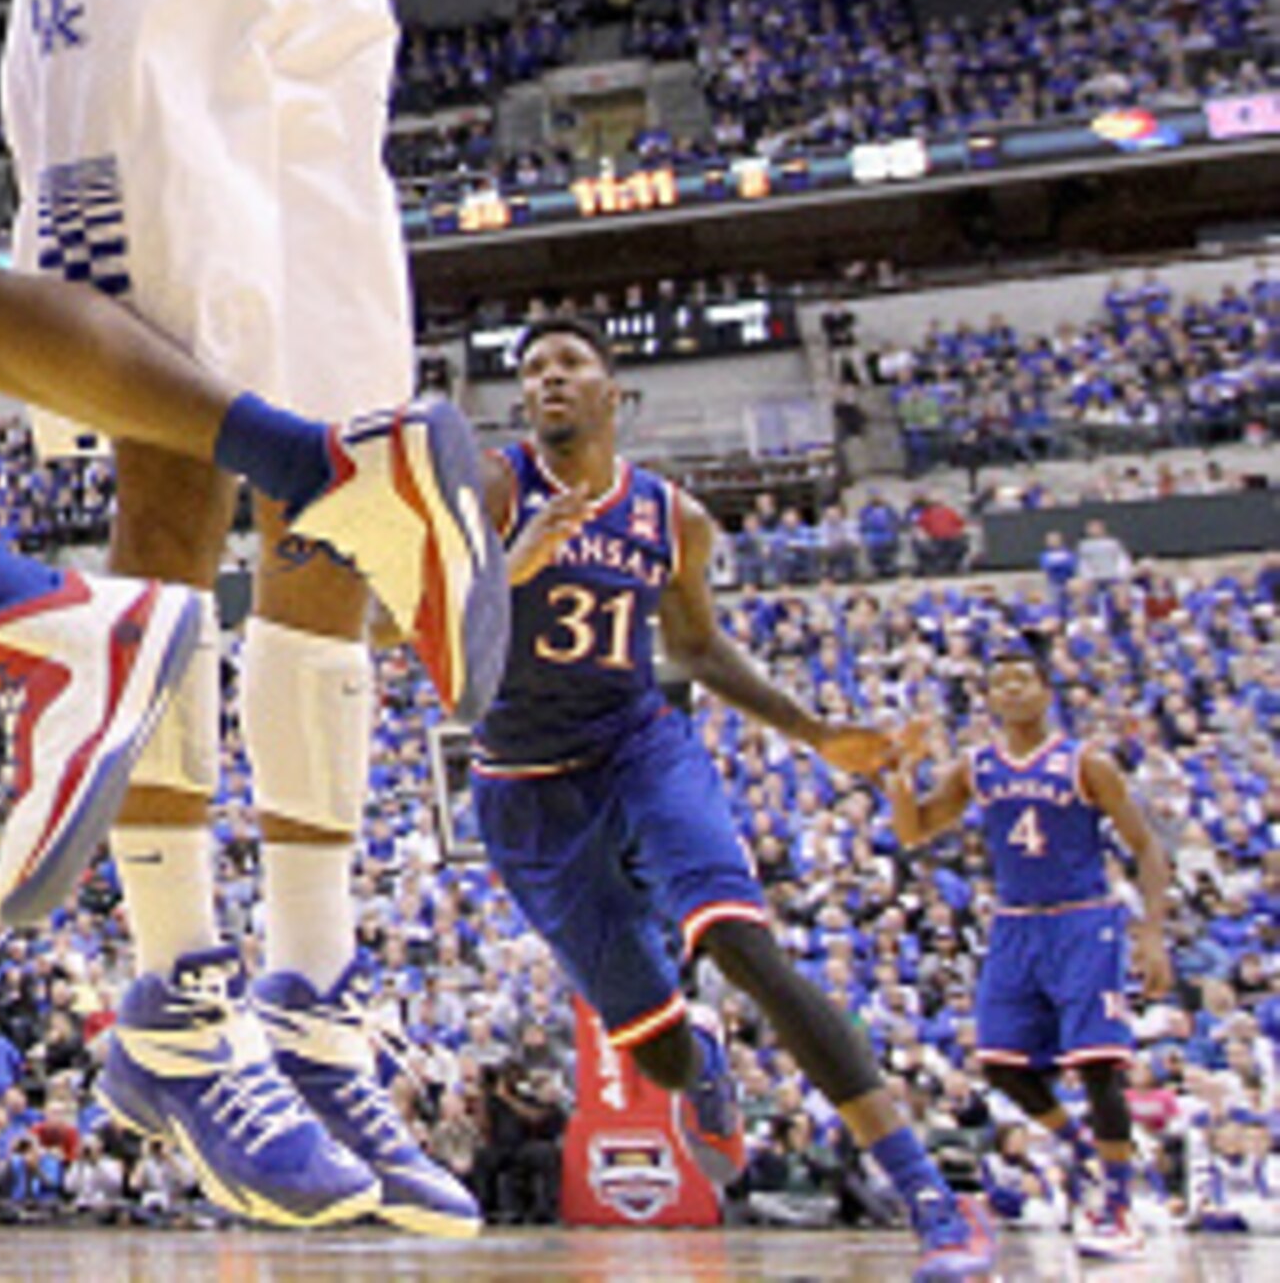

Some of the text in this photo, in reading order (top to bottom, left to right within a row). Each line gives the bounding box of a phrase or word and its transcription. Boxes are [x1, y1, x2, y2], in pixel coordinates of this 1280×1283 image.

[554, 533, 670, 588] ANSAS
[534, 582, 636, 671] 31
[1006, 803, 1049, 856] 4
